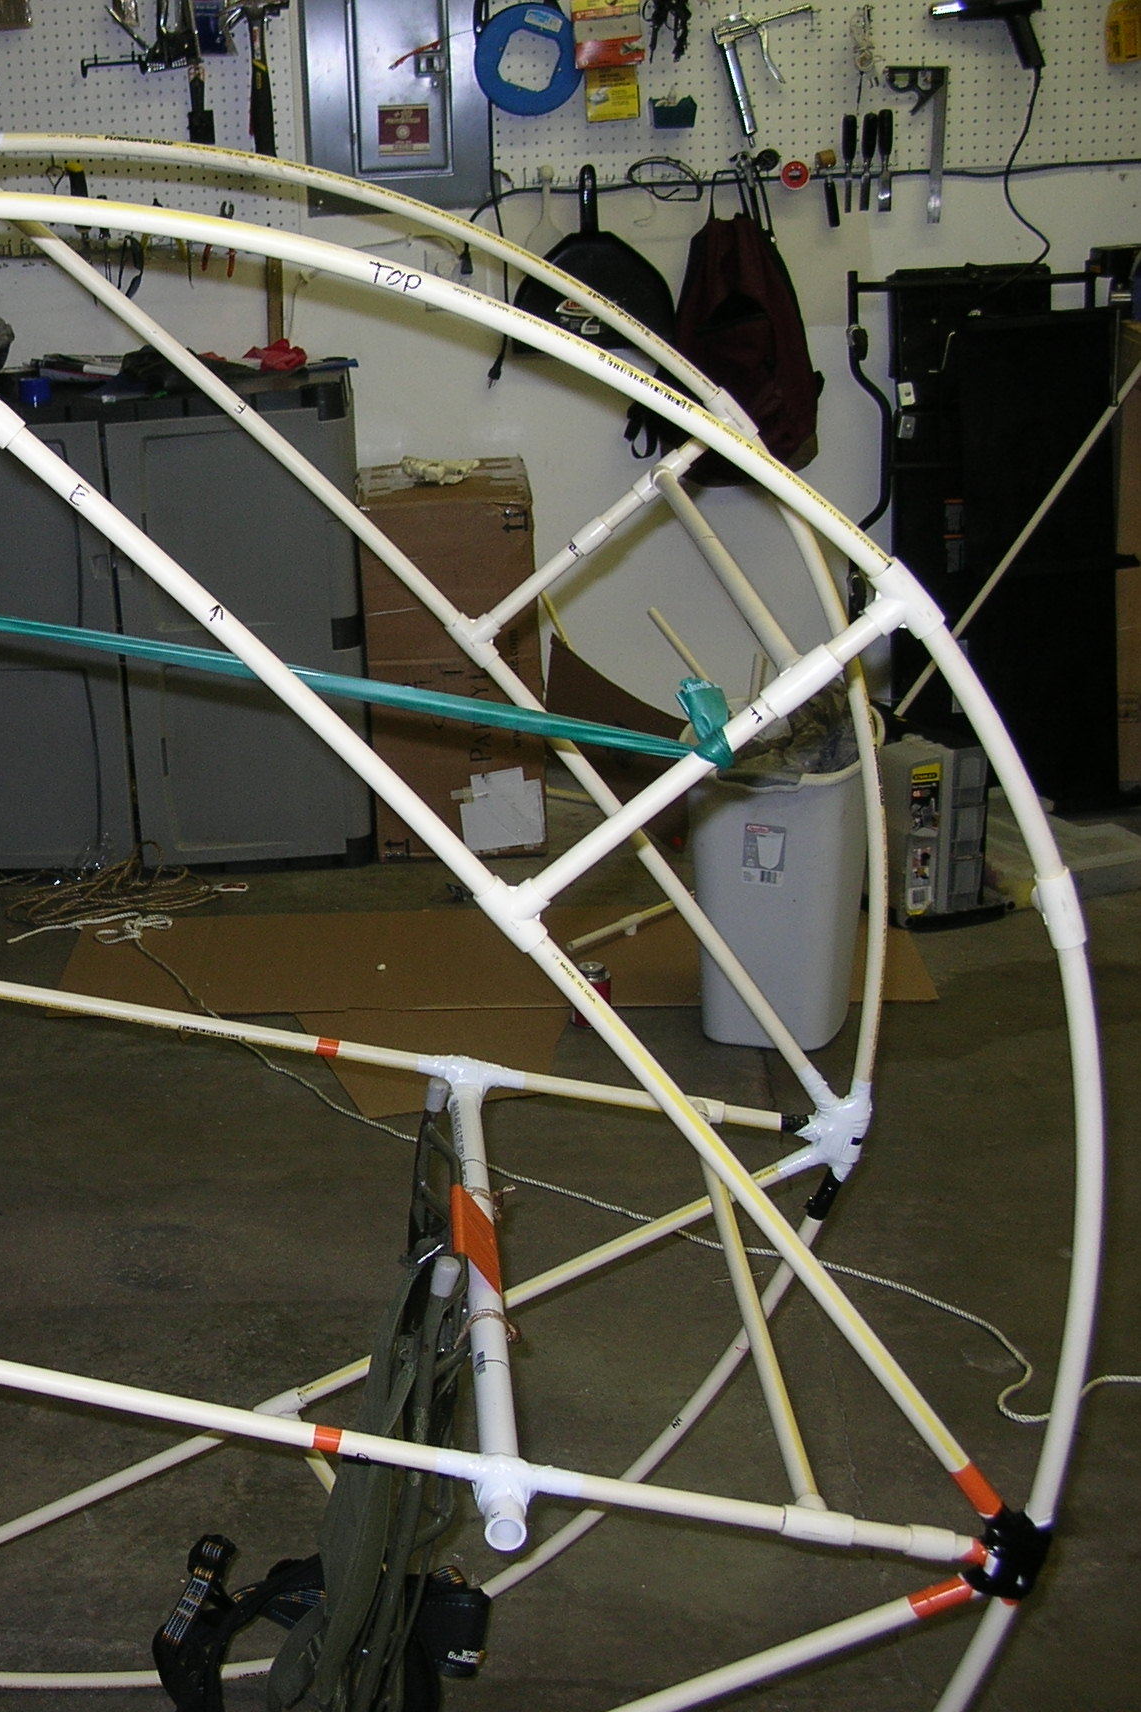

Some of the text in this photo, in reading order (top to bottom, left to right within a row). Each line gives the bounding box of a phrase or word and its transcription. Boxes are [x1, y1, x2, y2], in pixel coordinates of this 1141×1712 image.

[369, 260, 422, 302] TOP
[69, 483, 90, 507] E
[560, 961, 576, 980] MADE
